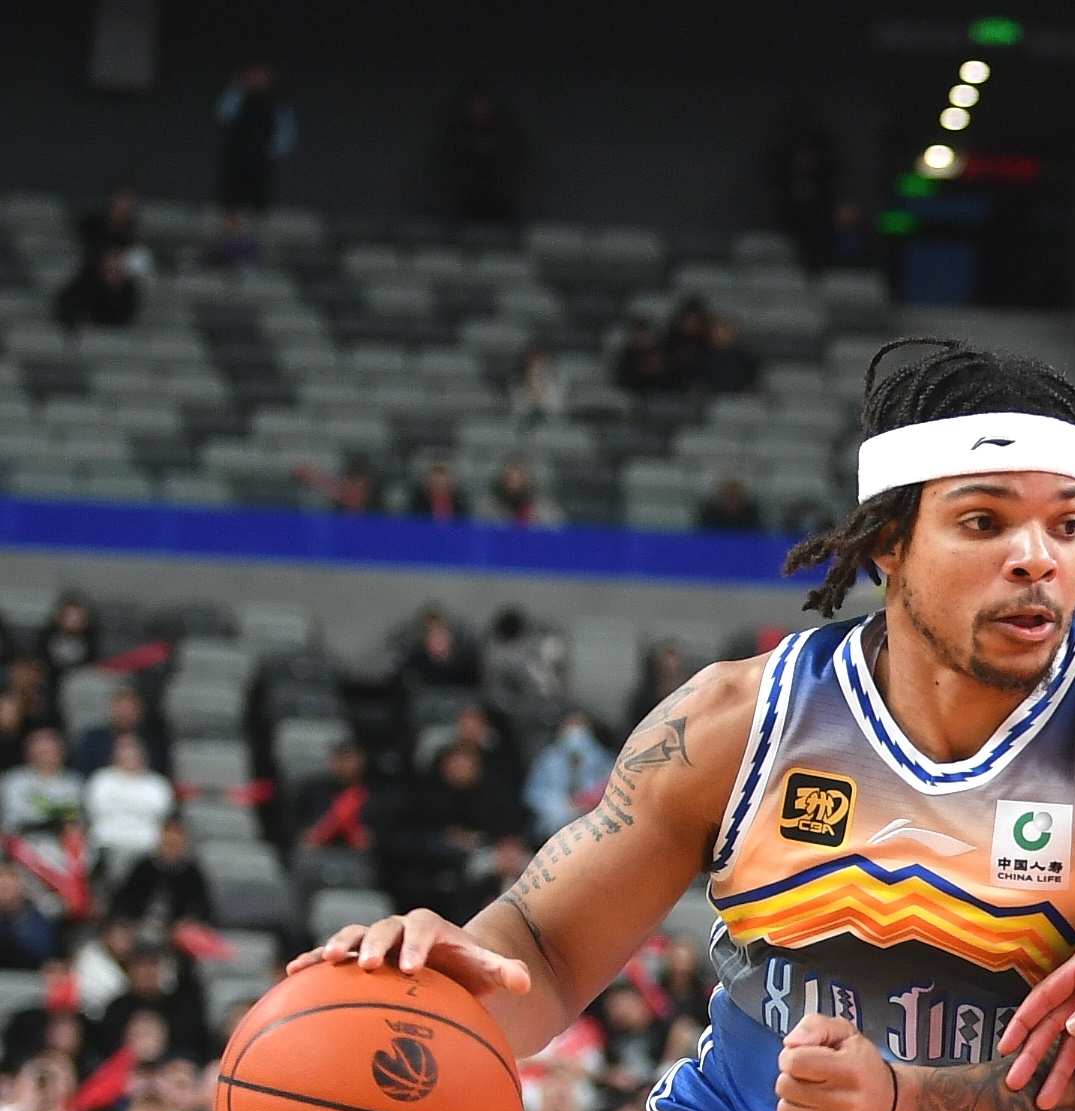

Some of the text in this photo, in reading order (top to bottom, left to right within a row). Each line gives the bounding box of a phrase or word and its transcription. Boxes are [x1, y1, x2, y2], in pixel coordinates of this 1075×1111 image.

[798, 819, 836, 836] CBA
[997, 856, 1063, 873] 中国人寿
[997, 872, 1063, 883] CHINA LIFE
